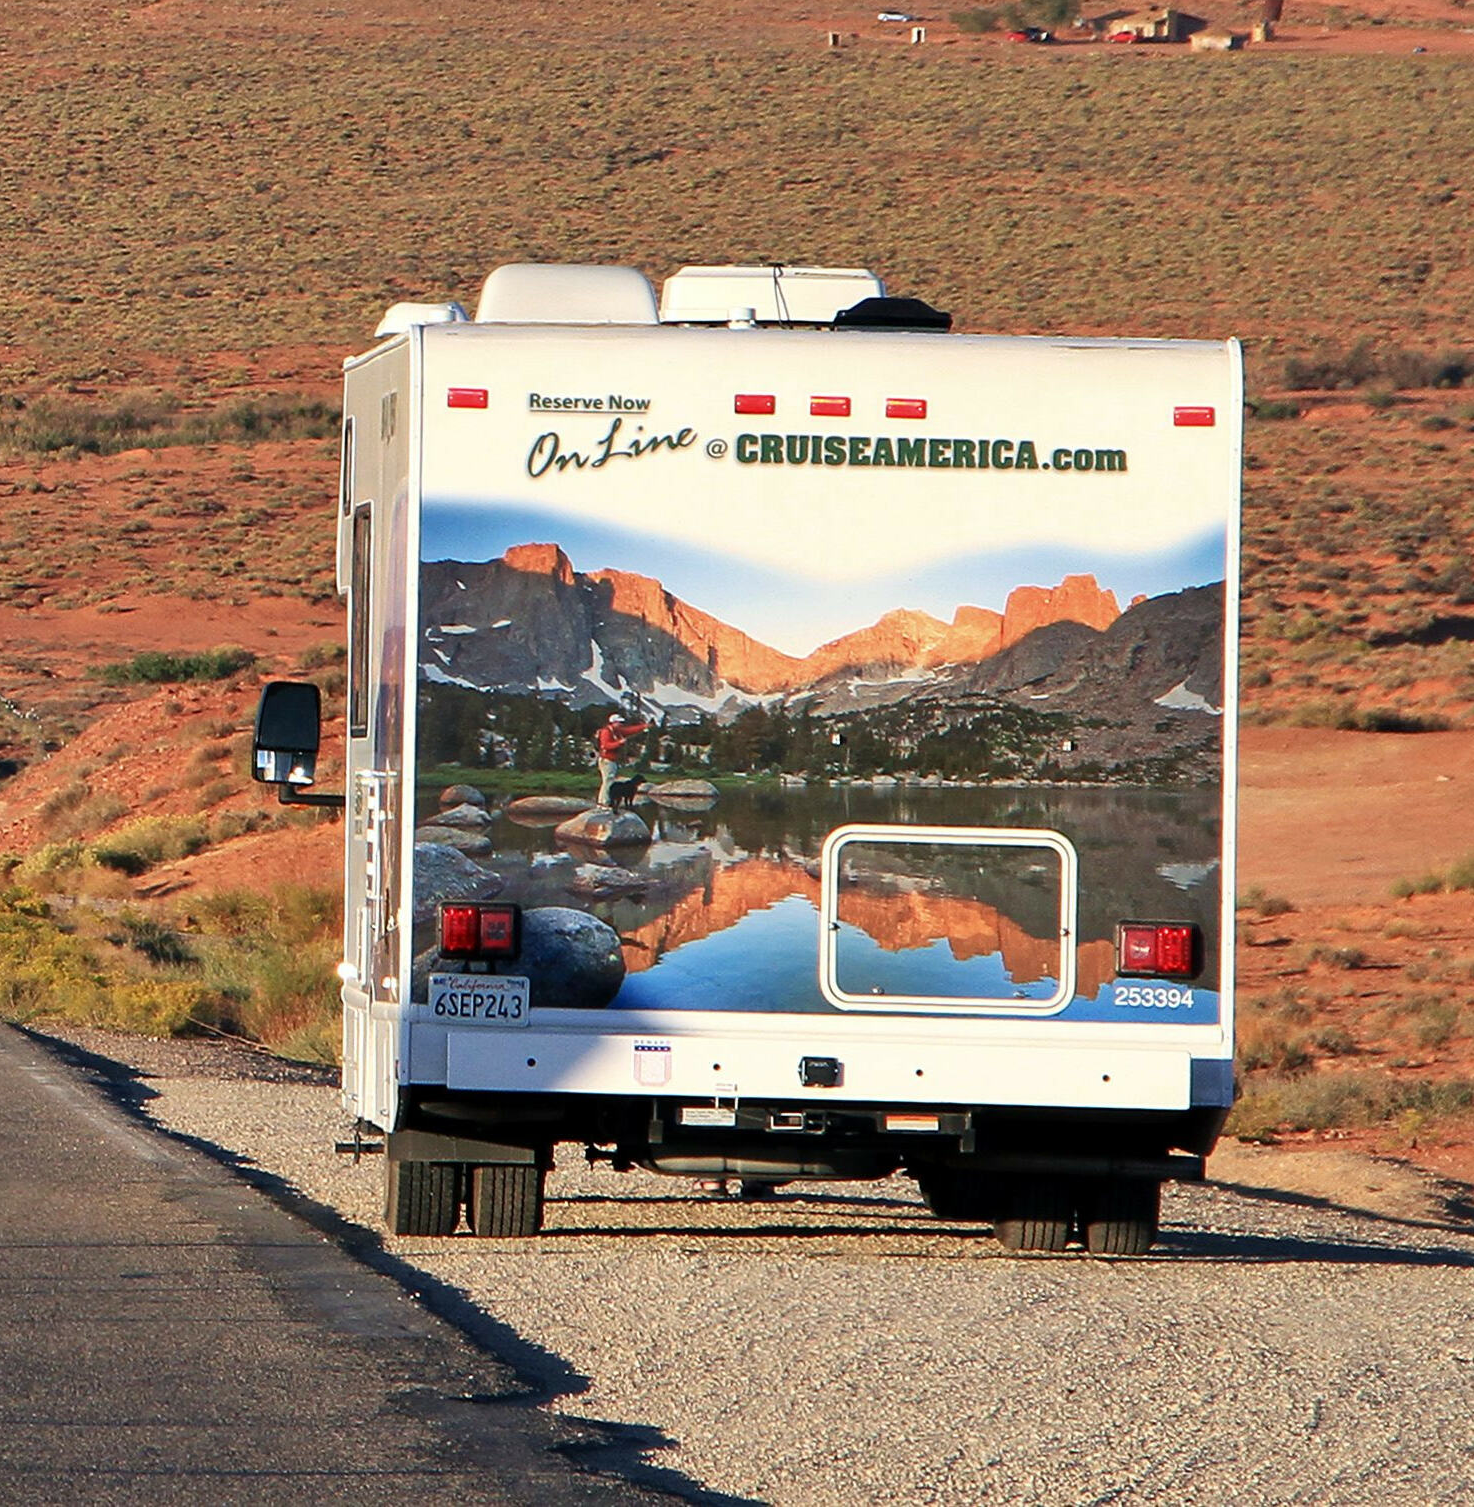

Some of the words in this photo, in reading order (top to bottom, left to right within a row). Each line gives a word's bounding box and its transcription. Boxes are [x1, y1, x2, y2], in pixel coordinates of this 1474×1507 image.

[529, 393, 603, 410] Reserve
[609, 395, 651, 411] Now
[527, 432, 590, 478] On
[591, 417, 698, 468] Line
[706, 438, 728, 459] @
[735, 433, 1127, 471] CRUISEAMERICA.com
[434, 993, 522, 1019] 6SEP243
[1114, 986, 1194, 1008] 253394
